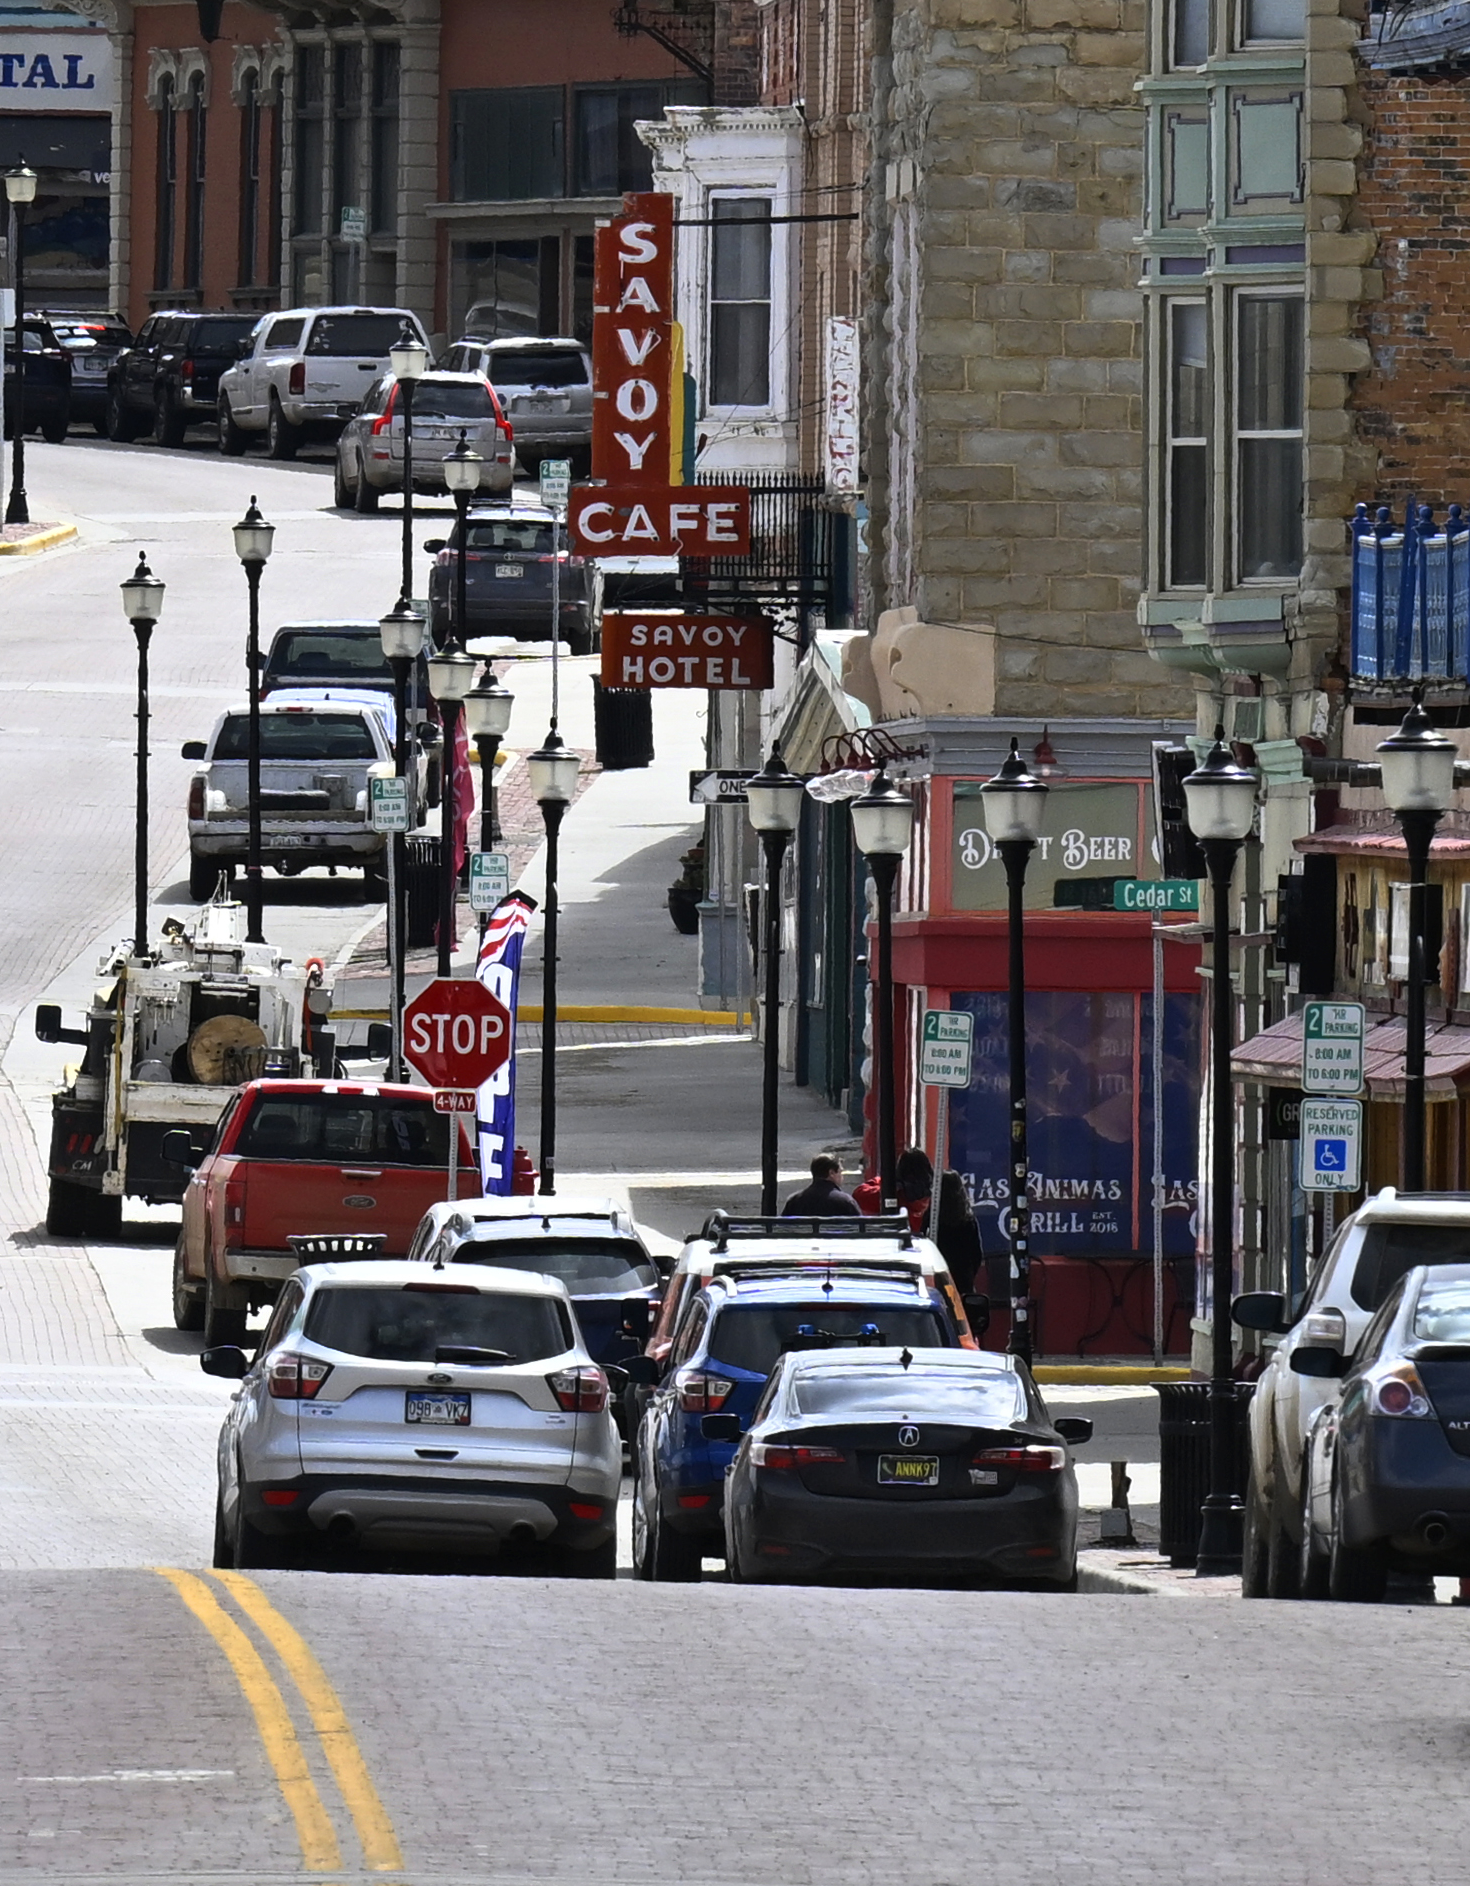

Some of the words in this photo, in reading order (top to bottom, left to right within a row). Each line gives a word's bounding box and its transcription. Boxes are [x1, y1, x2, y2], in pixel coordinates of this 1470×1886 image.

[614, 222, 660, 471] SAVOY
[577, 502, 740, 543] CAFE
[630, 625, 749, 647] SAVOY
[622, 655, 751, 686] HOTEL
[374, 781, 382, 794] 2
[719, 780, 747, 794] ONE
[474, 857, 481, 871] 2
[1124, 883, 1174, 907] Cedar
[1179, 887, 1192, 903] St
[927, 1016, 936, 1034] 2
[1309, 1008, 1319, 1031] 2
[410, 1012, 505, 1055] STOP
[1324, 1022, 1358, 1034] PARKING
[1315, 1048, 1334, 1060] 8:00
[1336, 1048, 1352, 1060] AM
[1308, 1068, 1319, 1079] TO
[1321, 1068, 1340, 1080] 6:00
[1343, 1069, 1358, 1080] PM
[437, 1094, 474, 1110] 4-WAY
[1306, 1107, 1358, 1121] RESERVED
[1308, 1124, 1353, 1136] PARKING
[1027, 1170, 1122, 1201] ANIMAS
[1315, 1173, 1344, 1185] ONLY
